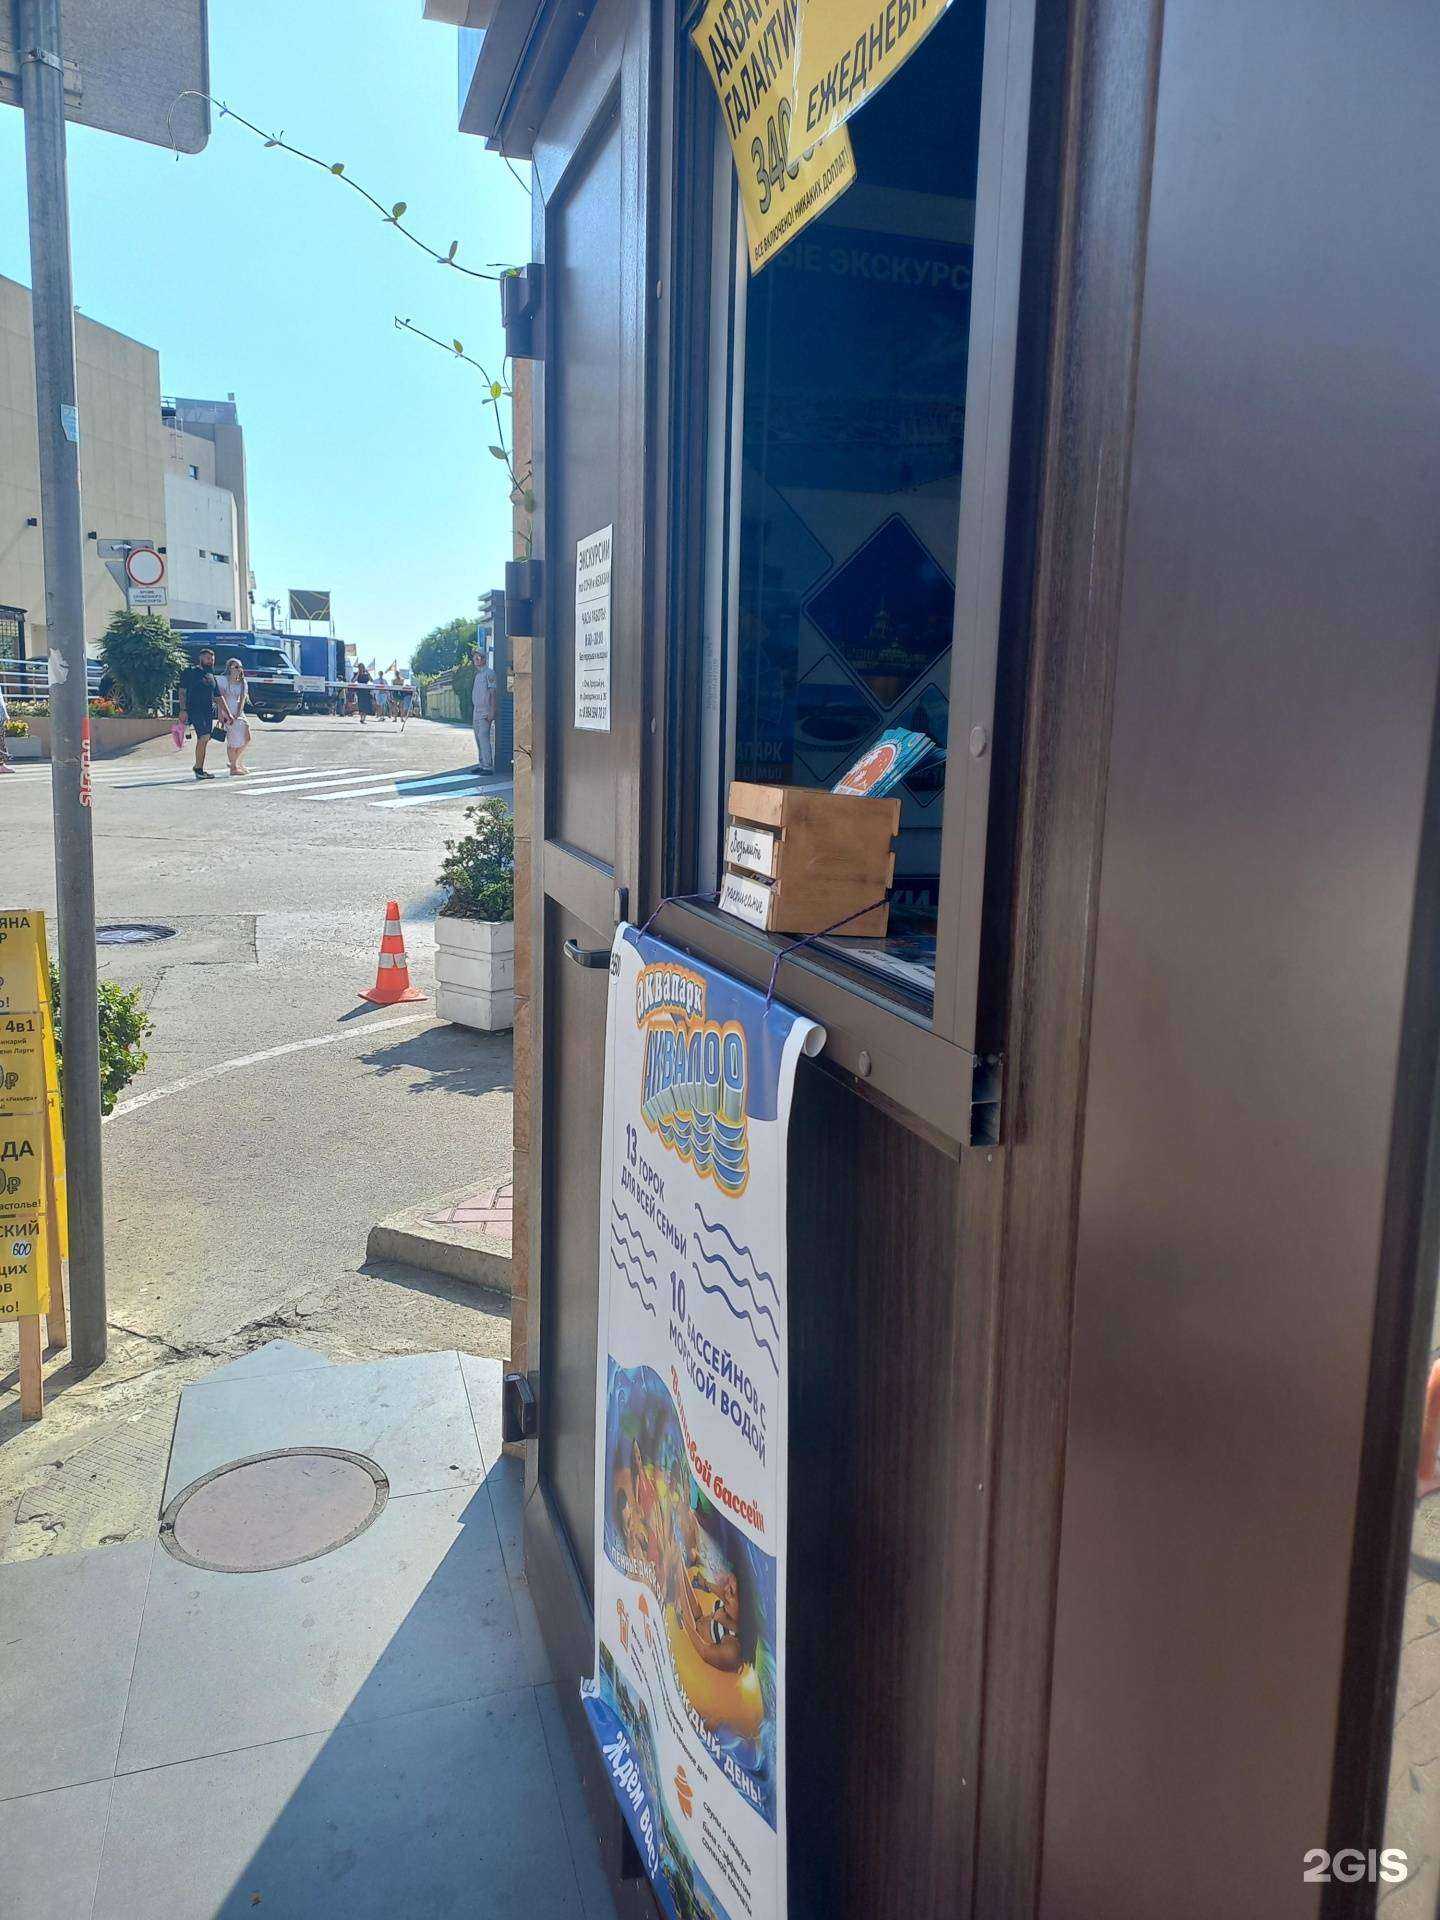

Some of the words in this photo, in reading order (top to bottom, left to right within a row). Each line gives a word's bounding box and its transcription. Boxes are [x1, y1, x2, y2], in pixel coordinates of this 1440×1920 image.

[793, 180, 824, 219] НИКАКИХ
[6, 1019, 36, 1033] 4в1
[626, 1123, 638, 1168] 13
[639, 1155, 666, 1203] ГОРОК
[621, 1164, 637, 1199] ДЛЯ
[636, 1181, 656, 1224] ВСЕЙ
[656, 1208, 688, 1261] СЕМЬИ
[670, 1270, 687, 1324] 10
[687, 1314, 759, 1417] БАССЕЙНОВ
[669, 1318, 717, 1407] МОРСКОЙ
[720, 1388, 766, 1470] ВОДОЙ
[602, 1730, 645, 1812] Ждём
[640, 1805, 660, 1880] вас!
